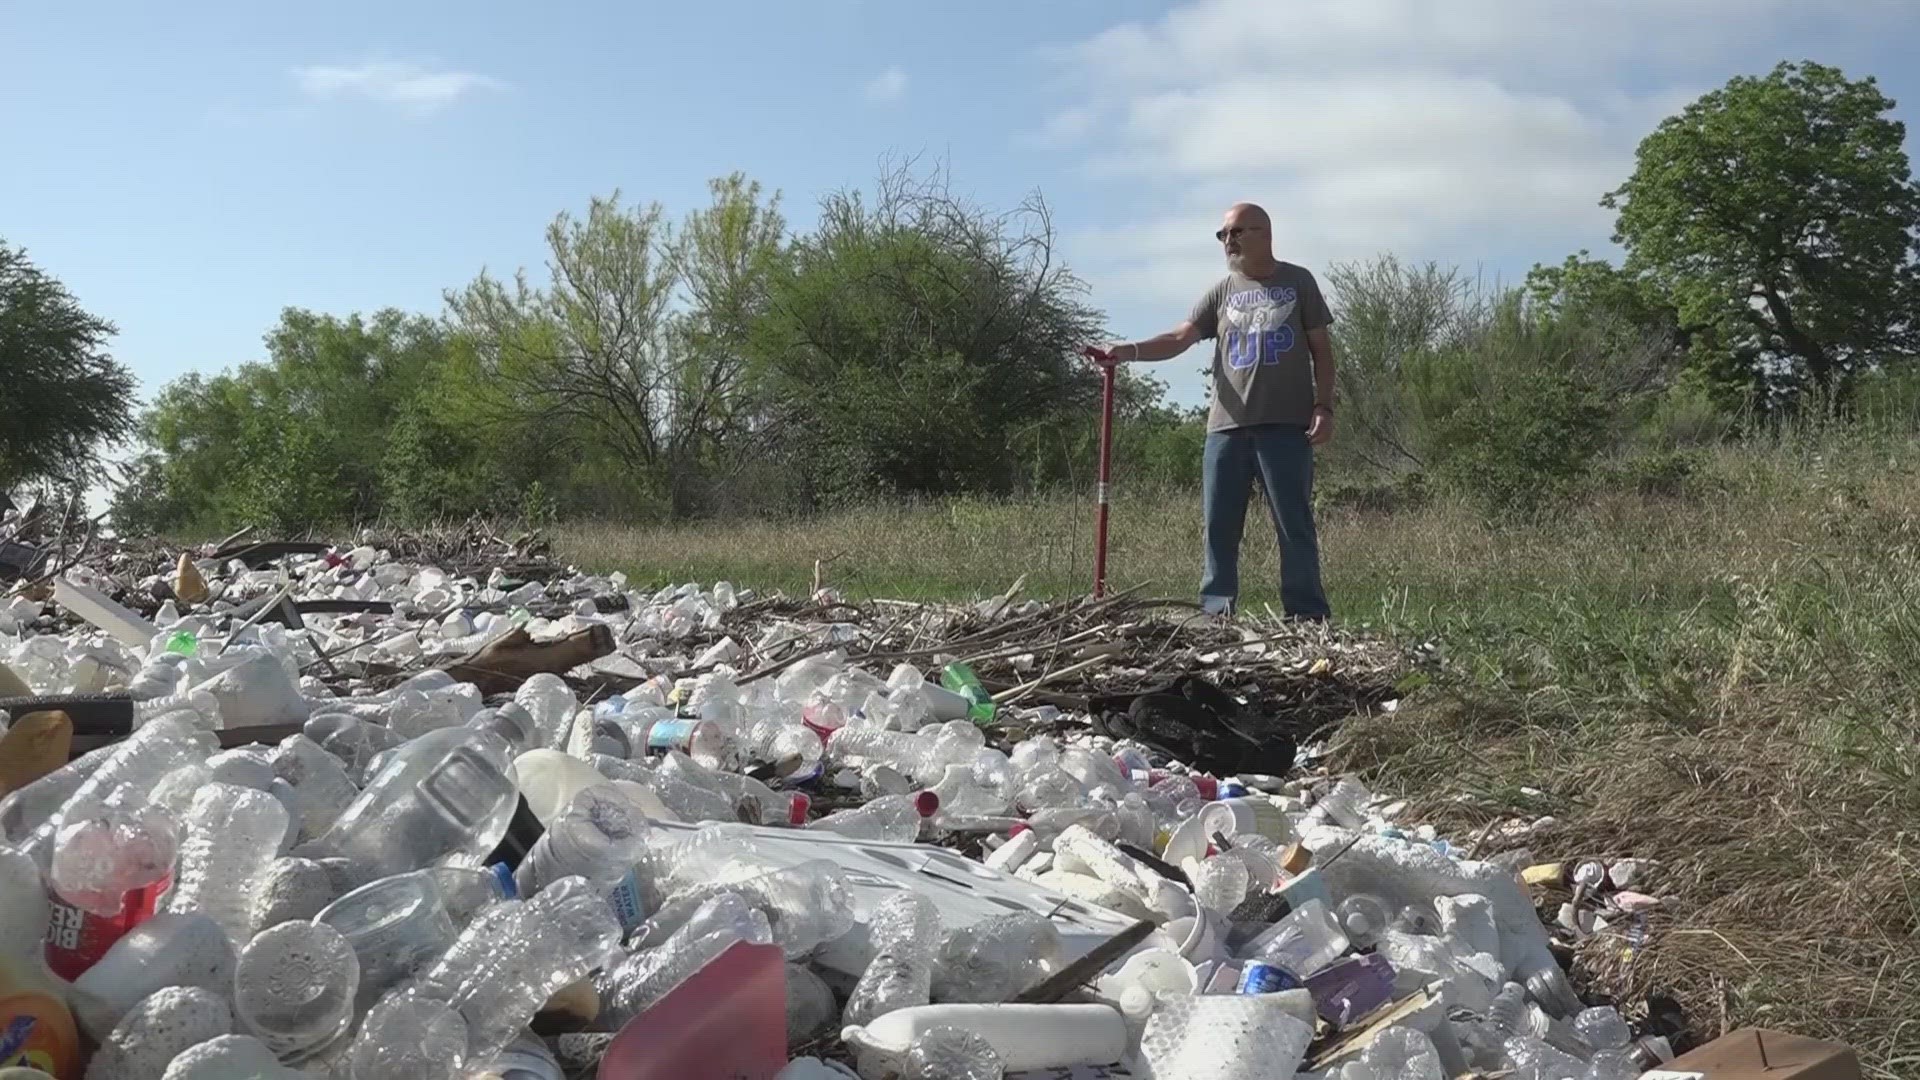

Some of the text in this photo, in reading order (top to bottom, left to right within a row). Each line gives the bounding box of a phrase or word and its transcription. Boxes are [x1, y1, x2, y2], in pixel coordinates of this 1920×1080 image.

[1226, 287, 1297, 309] WINGS
[1226, 323, 1295, 369] UP
[47, 900, 84, 929] RE
